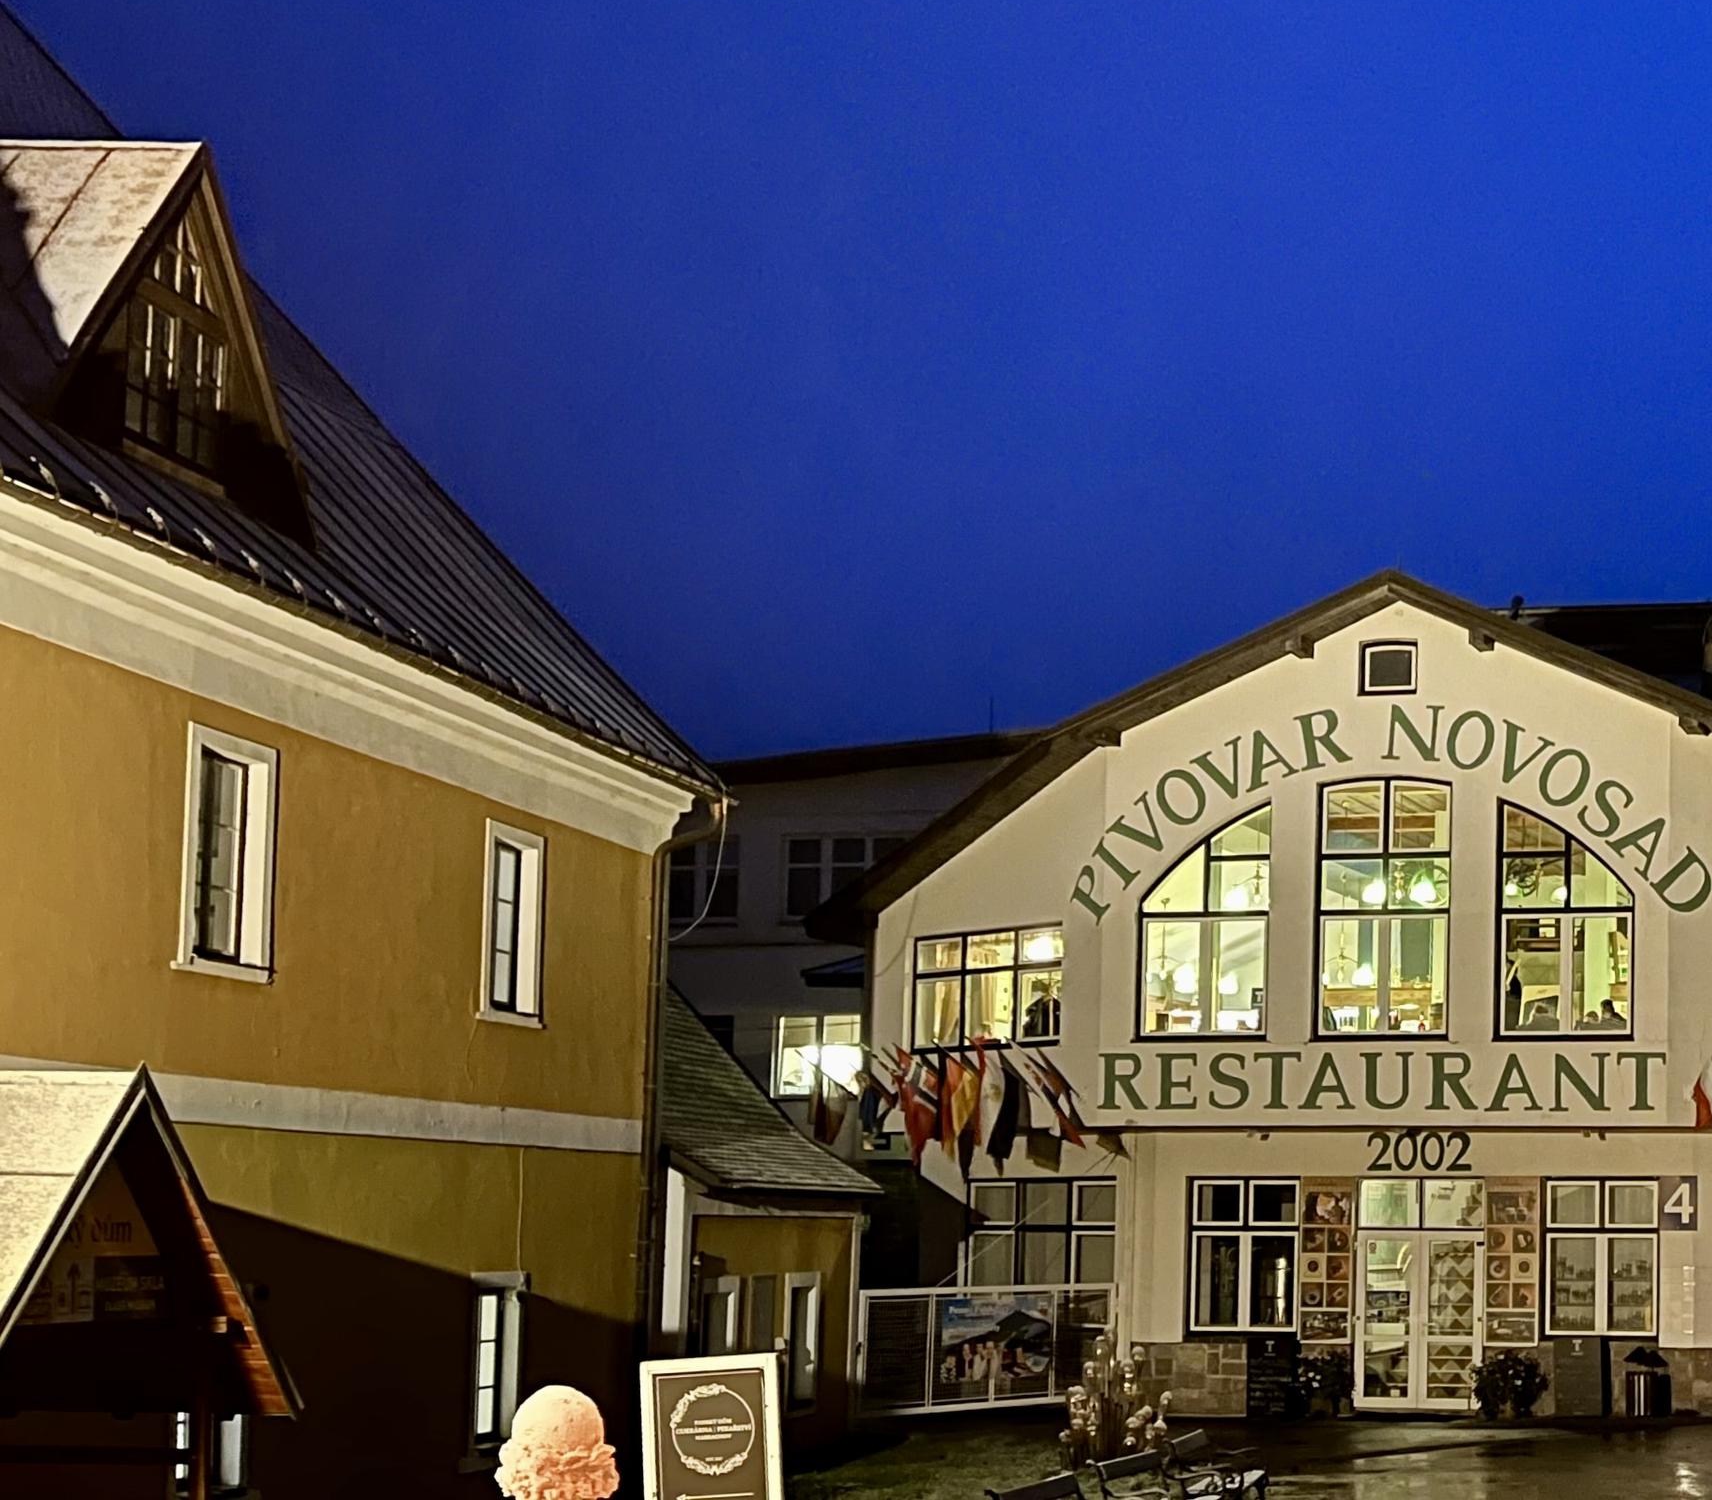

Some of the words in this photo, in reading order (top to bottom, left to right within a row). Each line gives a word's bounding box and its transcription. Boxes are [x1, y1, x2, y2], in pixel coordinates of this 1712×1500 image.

[1070, 708, 1353, 926] PIVOVAR
[1381, 703, 1712, 913] NOVOSAD
[1097, 1051, 1667, 1111] RESTAURANT
[1366, 1130, 1472, 1172] 2002
[1663, 1182, 1694, 1224] 4
